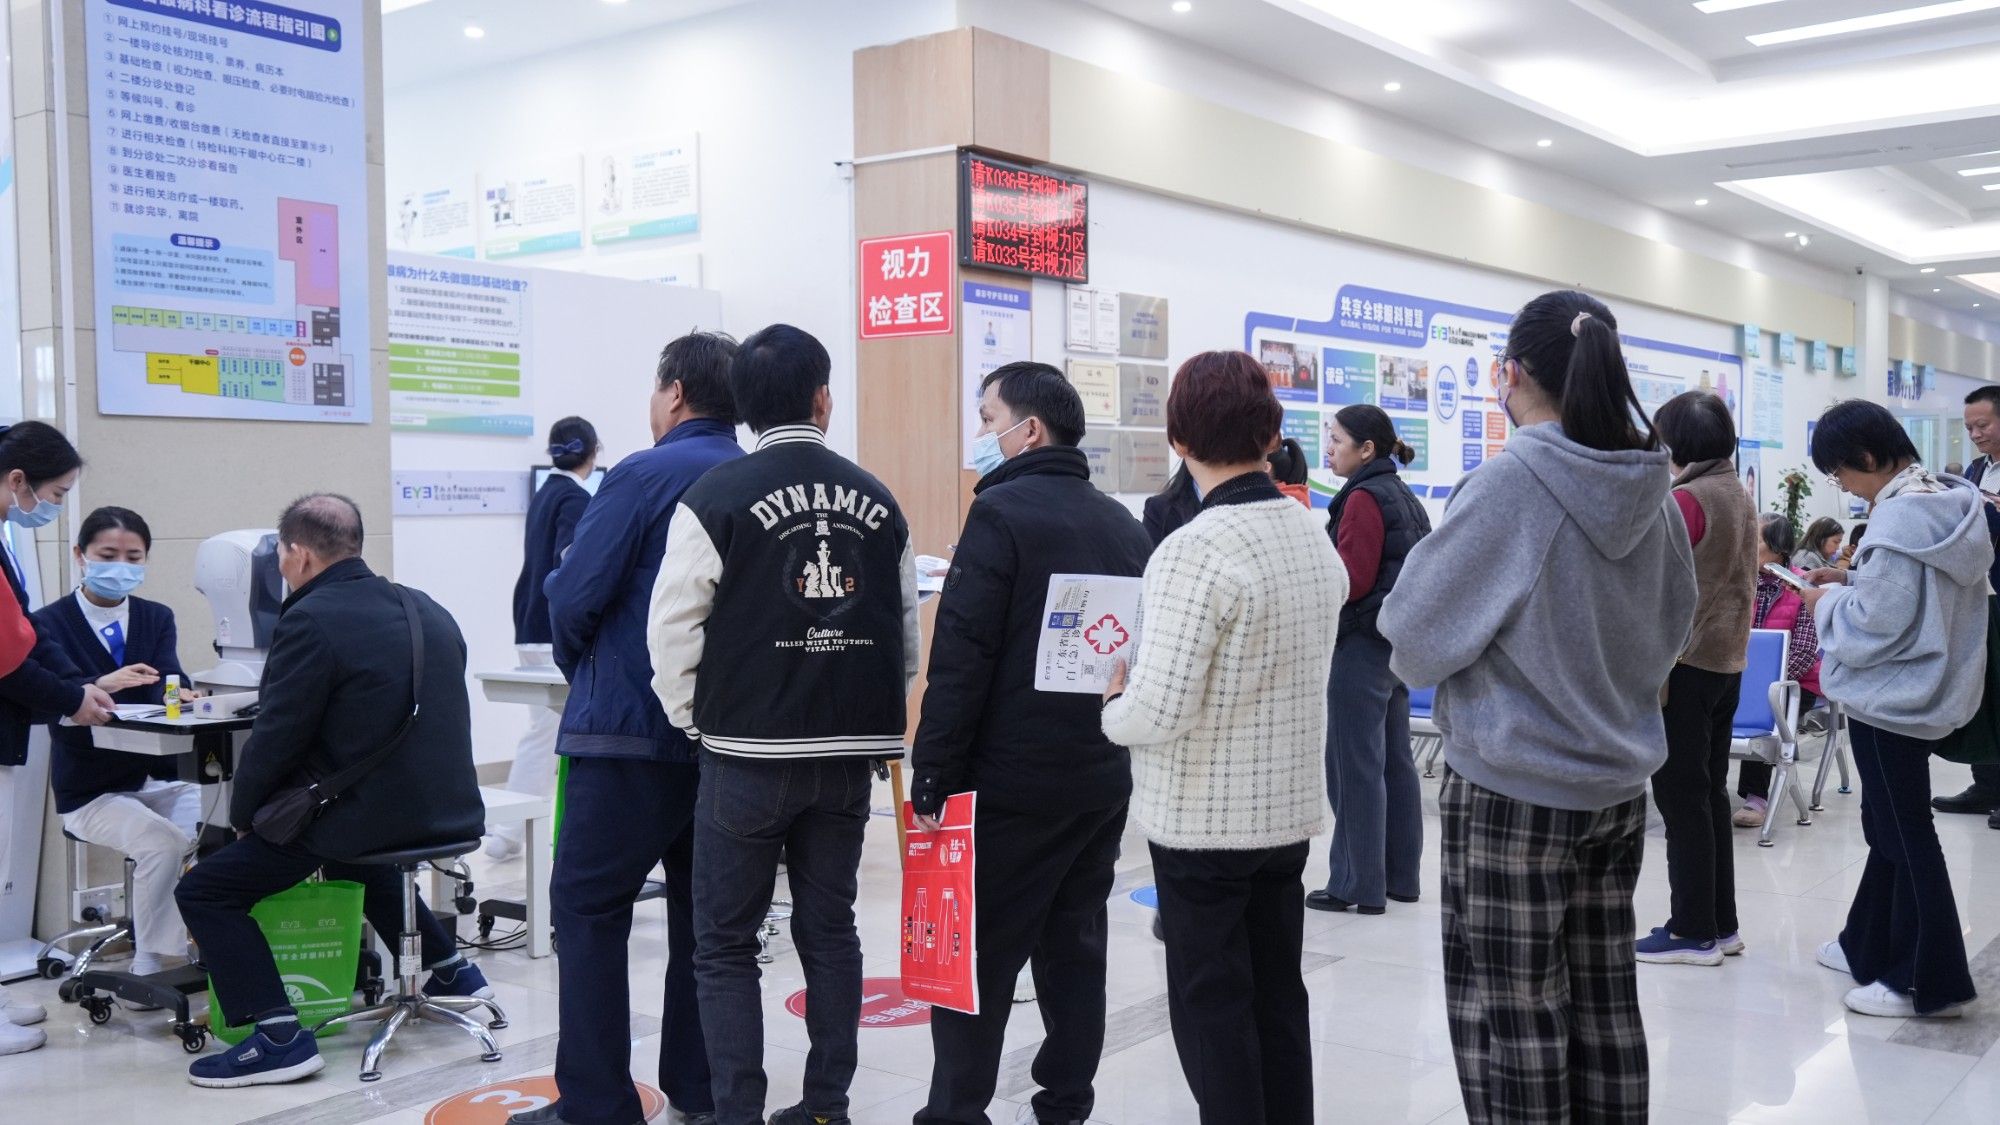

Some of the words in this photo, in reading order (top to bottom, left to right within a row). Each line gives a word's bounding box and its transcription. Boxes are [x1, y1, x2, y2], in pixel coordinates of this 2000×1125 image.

[971, 160, 1086, 200] 请K036号到视力区
[972, 213, 1086, 256] 请K034号到视力区
[881, 246, 930, 280] 视力
[972, 237, 1087, 279] 请K033号到视力区
[868, 292, 944, 327] 检查区
[1341, 296, 1424, 329] 共享全球眼科智慧
[749, 483, 889, 531] DYNAMIC
[775, 640, 804, 648] FILLED
[806, 639, 829, 647] WITH
[805, 645, 846, 653] VITALITY
[806, 626, 844, 640] Culture
